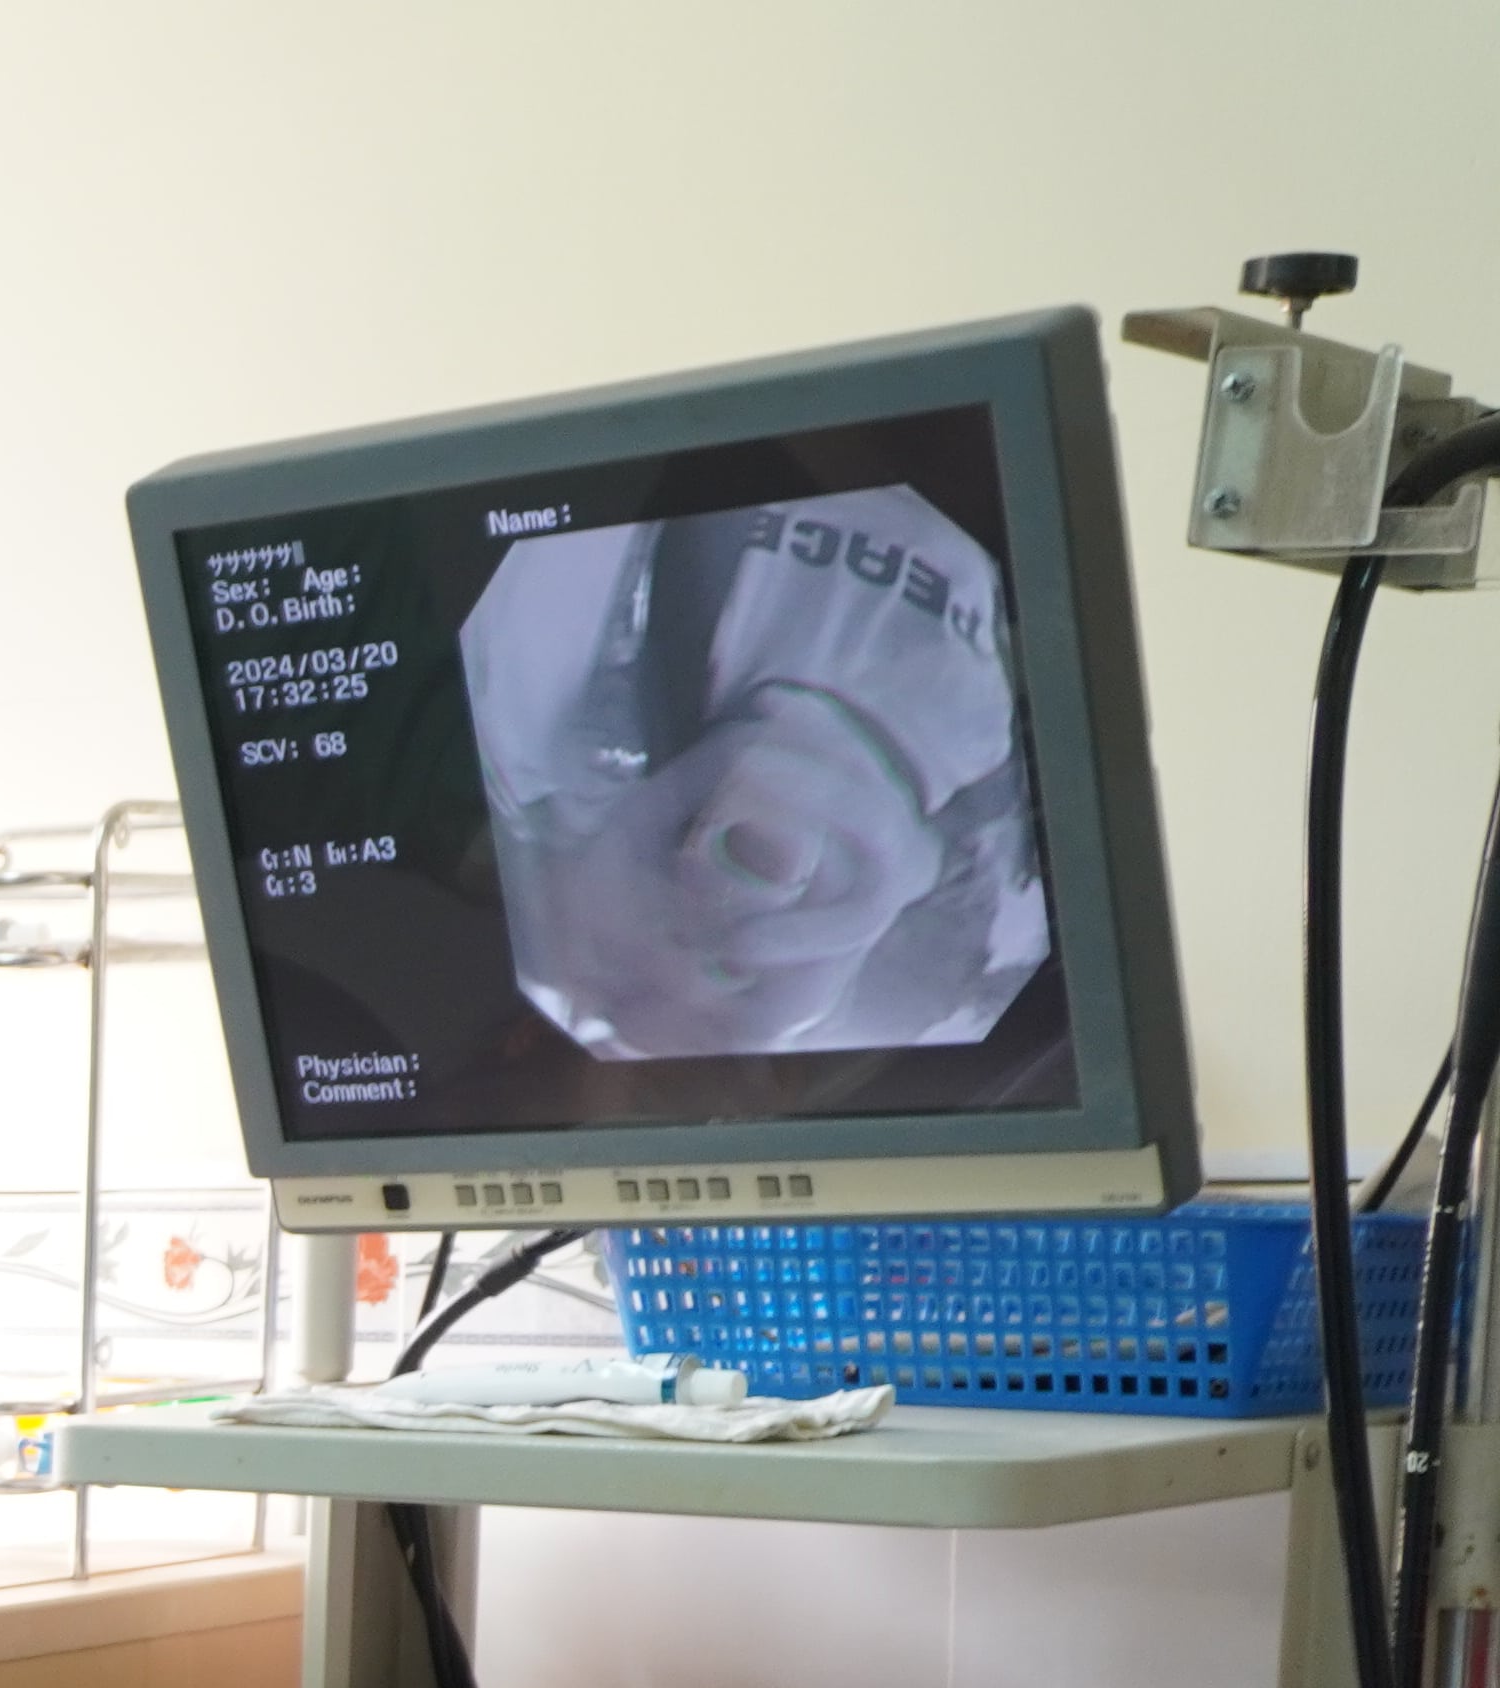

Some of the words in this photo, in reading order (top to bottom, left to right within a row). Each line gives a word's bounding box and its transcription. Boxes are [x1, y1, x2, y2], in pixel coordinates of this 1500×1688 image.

[486, 503, 572, 536] Name:
[212, 577, 271, 604] Sex:
[303, 563, 361, 593] Age:
[227, 641, 399, 687] 2024/03/20
[235, 672, 370, 712] 17:32:25
[241, 737, 299, 766] SCV:
[315, 731, 347, 757] 68
[297, 1051, 420, 1081] Physician:
[303, 1077, 417, 1105] Comment:
